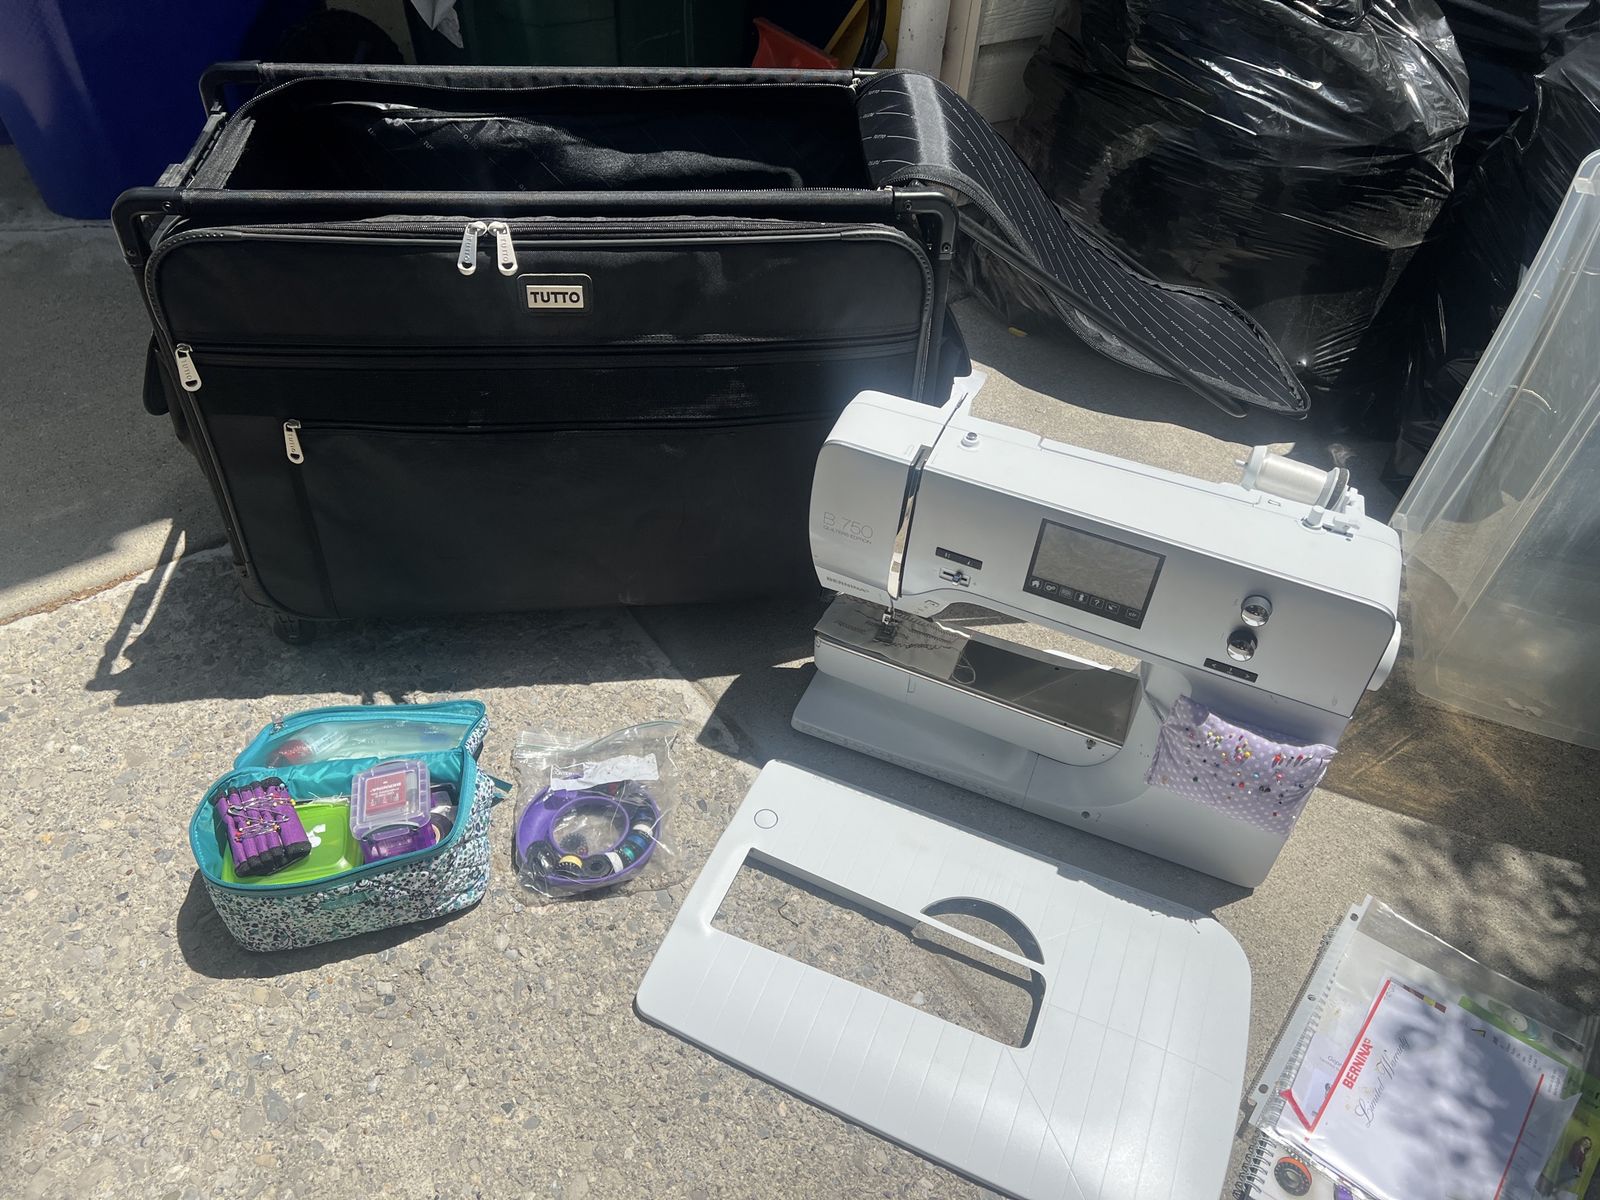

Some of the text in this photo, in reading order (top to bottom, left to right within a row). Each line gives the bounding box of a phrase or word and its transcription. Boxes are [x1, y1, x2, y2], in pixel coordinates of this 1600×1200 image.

[464, 238, 472, 262] TUTTO
[500, 238, 509, 262] TUTTO
[530, 291, 580, 303] TUTTO
[823, 511, 874, 539] B 750
[1342, 1041, 1373, 1090] BERNINA
[1354, 1038, 1409, 1128] Limited Warranty
